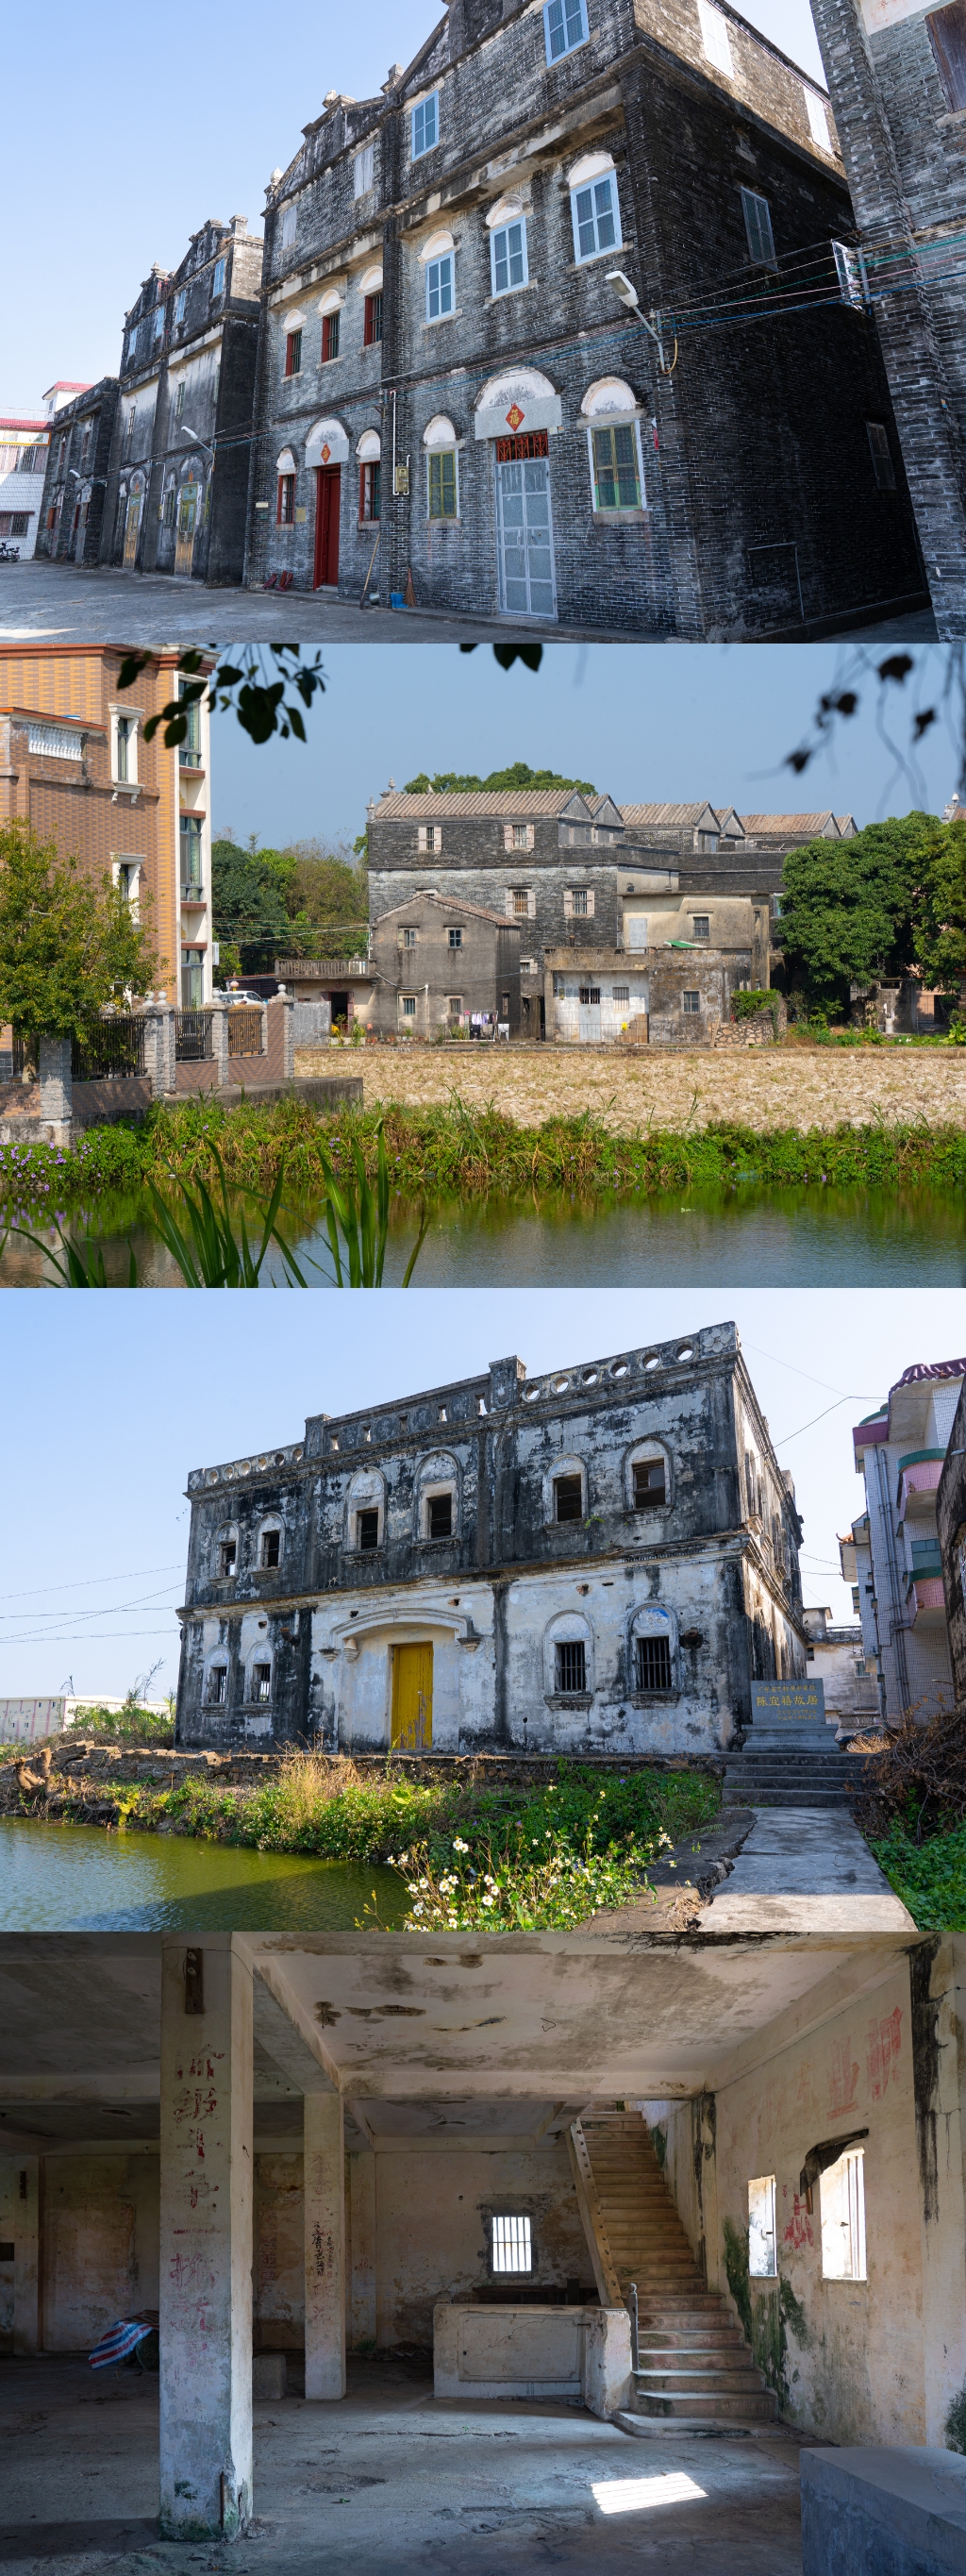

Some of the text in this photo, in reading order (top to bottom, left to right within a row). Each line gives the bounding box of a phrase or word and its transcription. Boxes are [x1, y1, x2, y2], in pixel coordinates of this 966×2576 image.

[509, 409, 520, 425] 福
[757, 1695, 819, 1706] 陈宜禧故居
